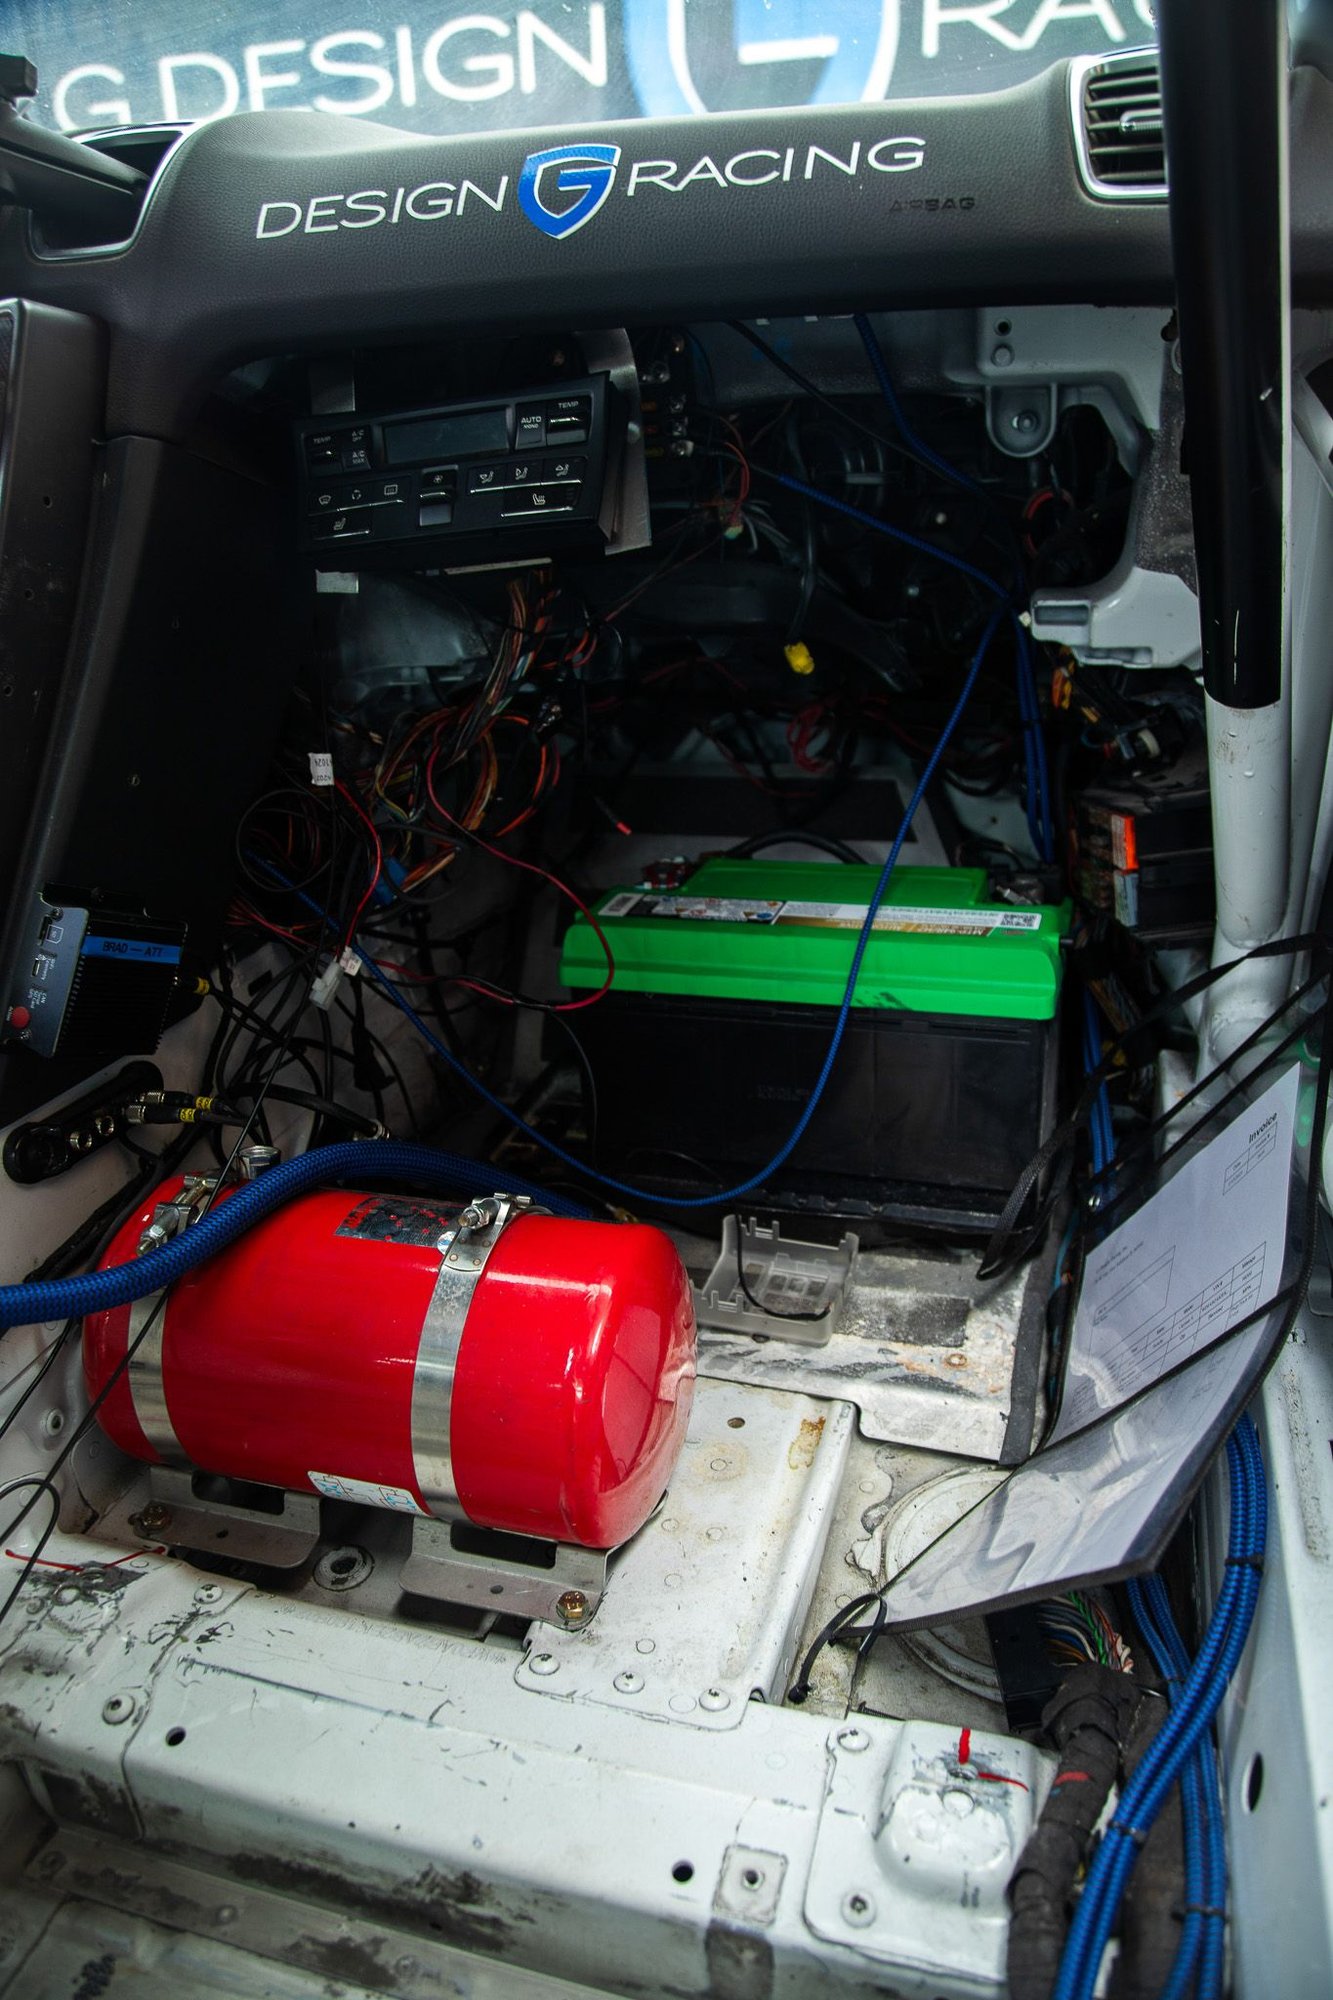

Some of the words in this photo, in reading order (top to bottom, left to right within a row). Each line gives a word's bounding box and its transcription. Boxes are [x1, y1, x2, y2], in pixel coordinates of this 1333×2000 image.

[157, 5, 609, 123] DESIGN
[256, 175, 509, 239] DESIGN
[627, 137, 926, 197] RACING
[521, 416, 542, 424] AUTO
[1249, 1112, 1278, 1143] Invoice
